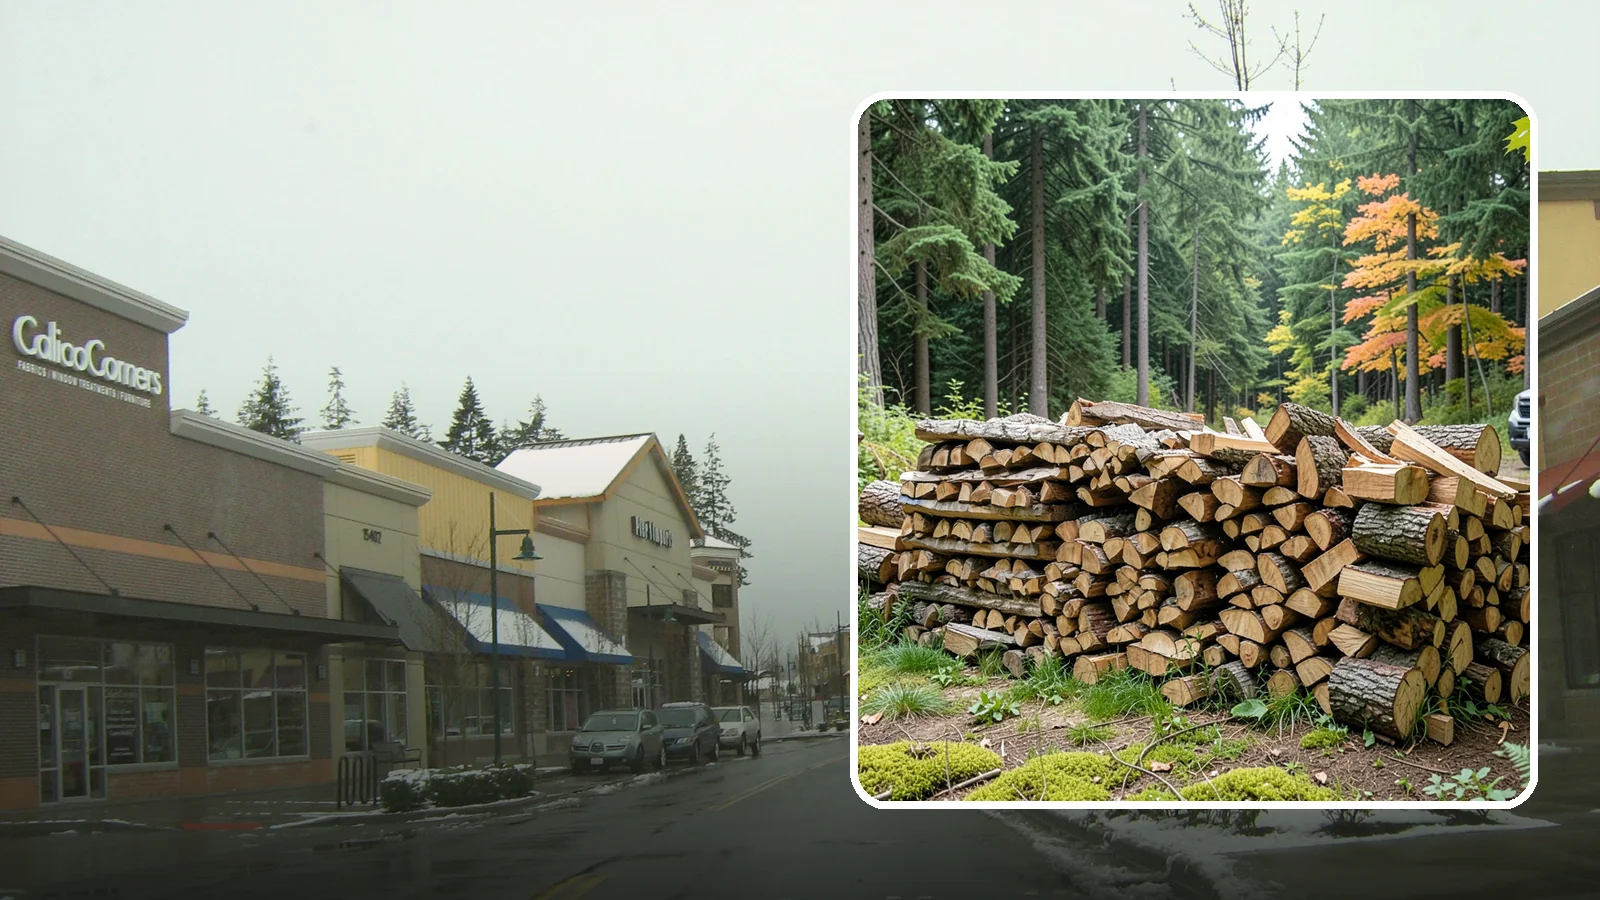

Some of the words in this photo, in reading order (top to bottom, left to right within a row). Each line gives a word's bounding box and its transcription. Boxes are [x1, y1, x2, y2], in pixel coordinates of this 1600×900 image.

[16, 359, 47, 377] FABRICS
[51, 369, 78, 387] WINDOW
[78, 378, 116, 398] TREATMENTS
[120, 391, 151, 409] FURNITURE
